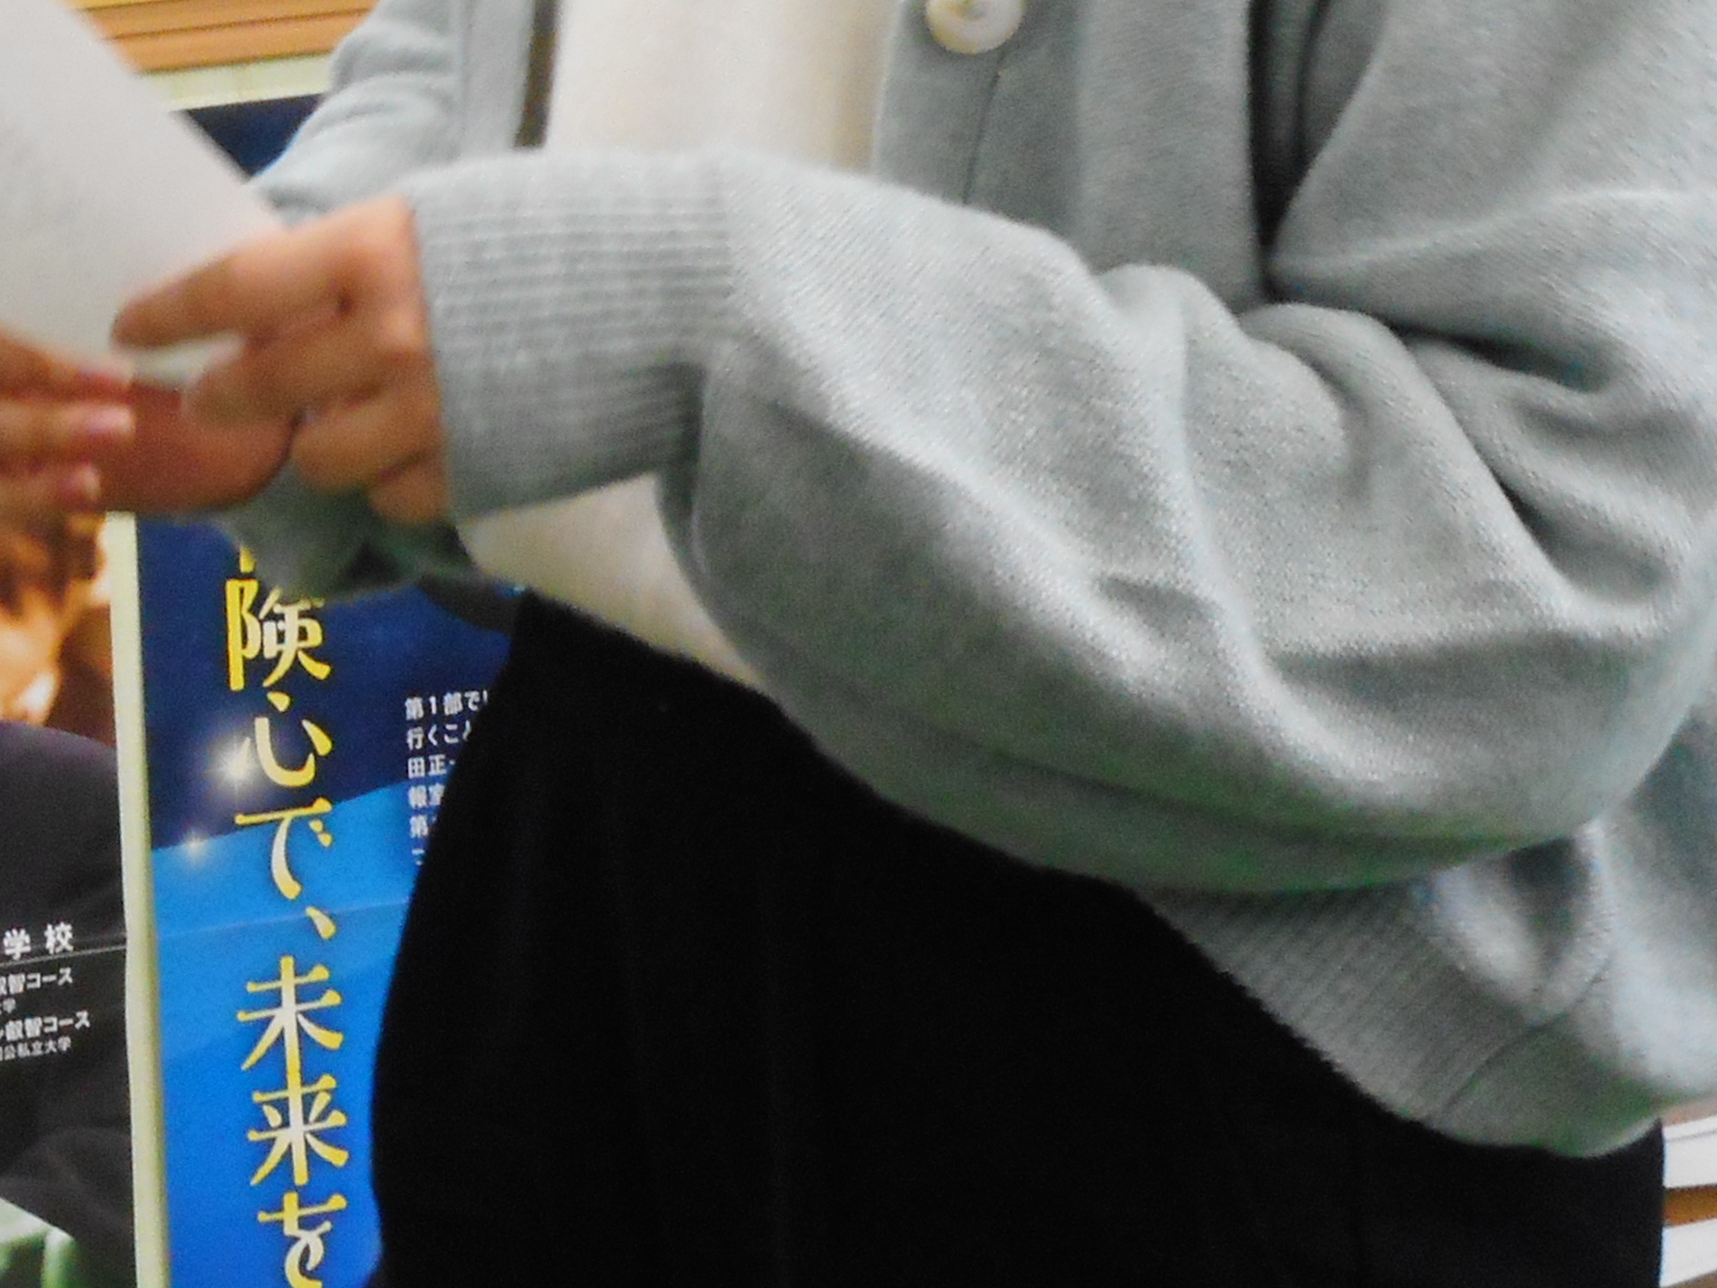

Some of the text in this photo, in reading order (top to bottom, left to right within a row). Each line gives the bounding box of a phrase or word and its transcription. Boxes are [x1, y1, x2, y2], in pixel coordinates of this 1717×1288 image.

[404, 689, 489, 721] 第1部で
[407, 753, 456, 780] 田正
[226, 546, 349, 1288] 険心で、未来を
